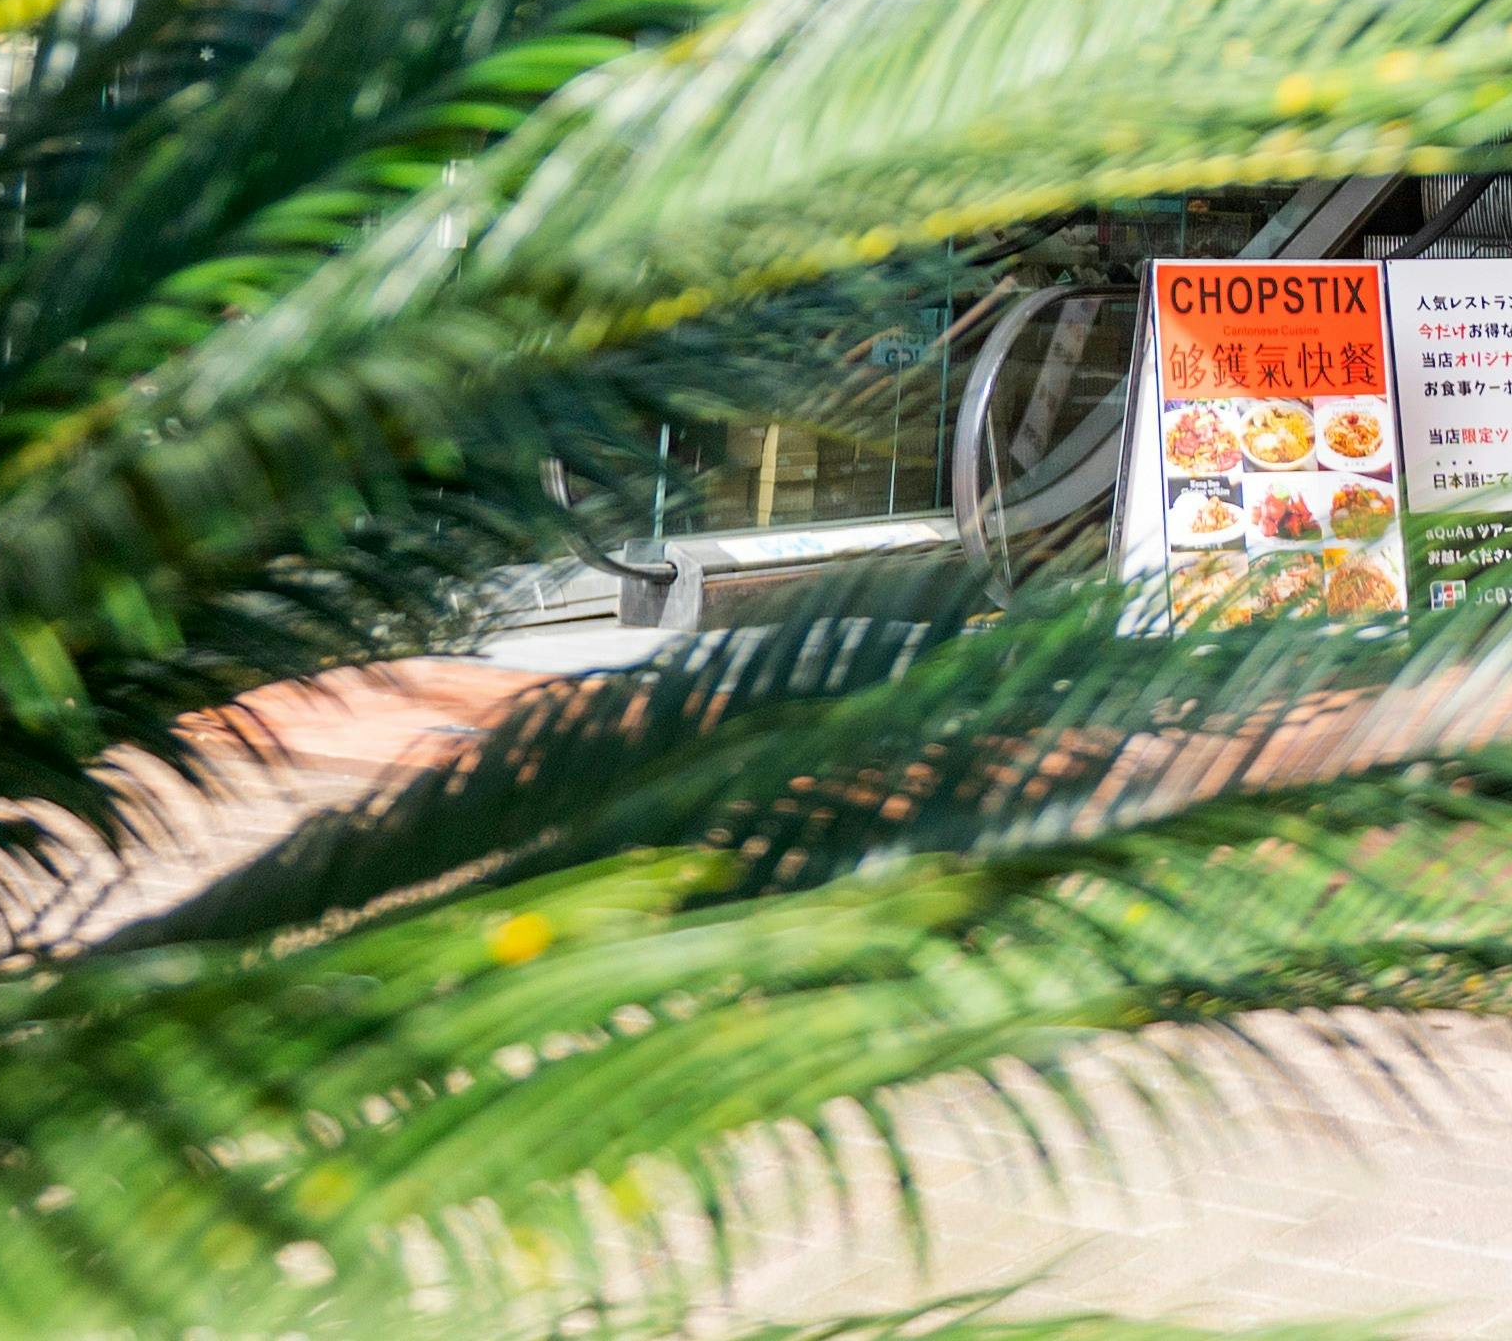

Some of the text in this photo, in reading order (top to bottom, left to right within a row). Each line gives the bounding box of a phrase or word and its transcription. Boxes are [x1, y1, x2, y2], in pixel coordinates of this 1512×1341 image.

[1171, 277, 1367, 314] CHOPSTIX
[1223, 325, 1320, 336] Cantonese Cuisine
[1168, 342, 1378, 390] 够鑊氣快餐
